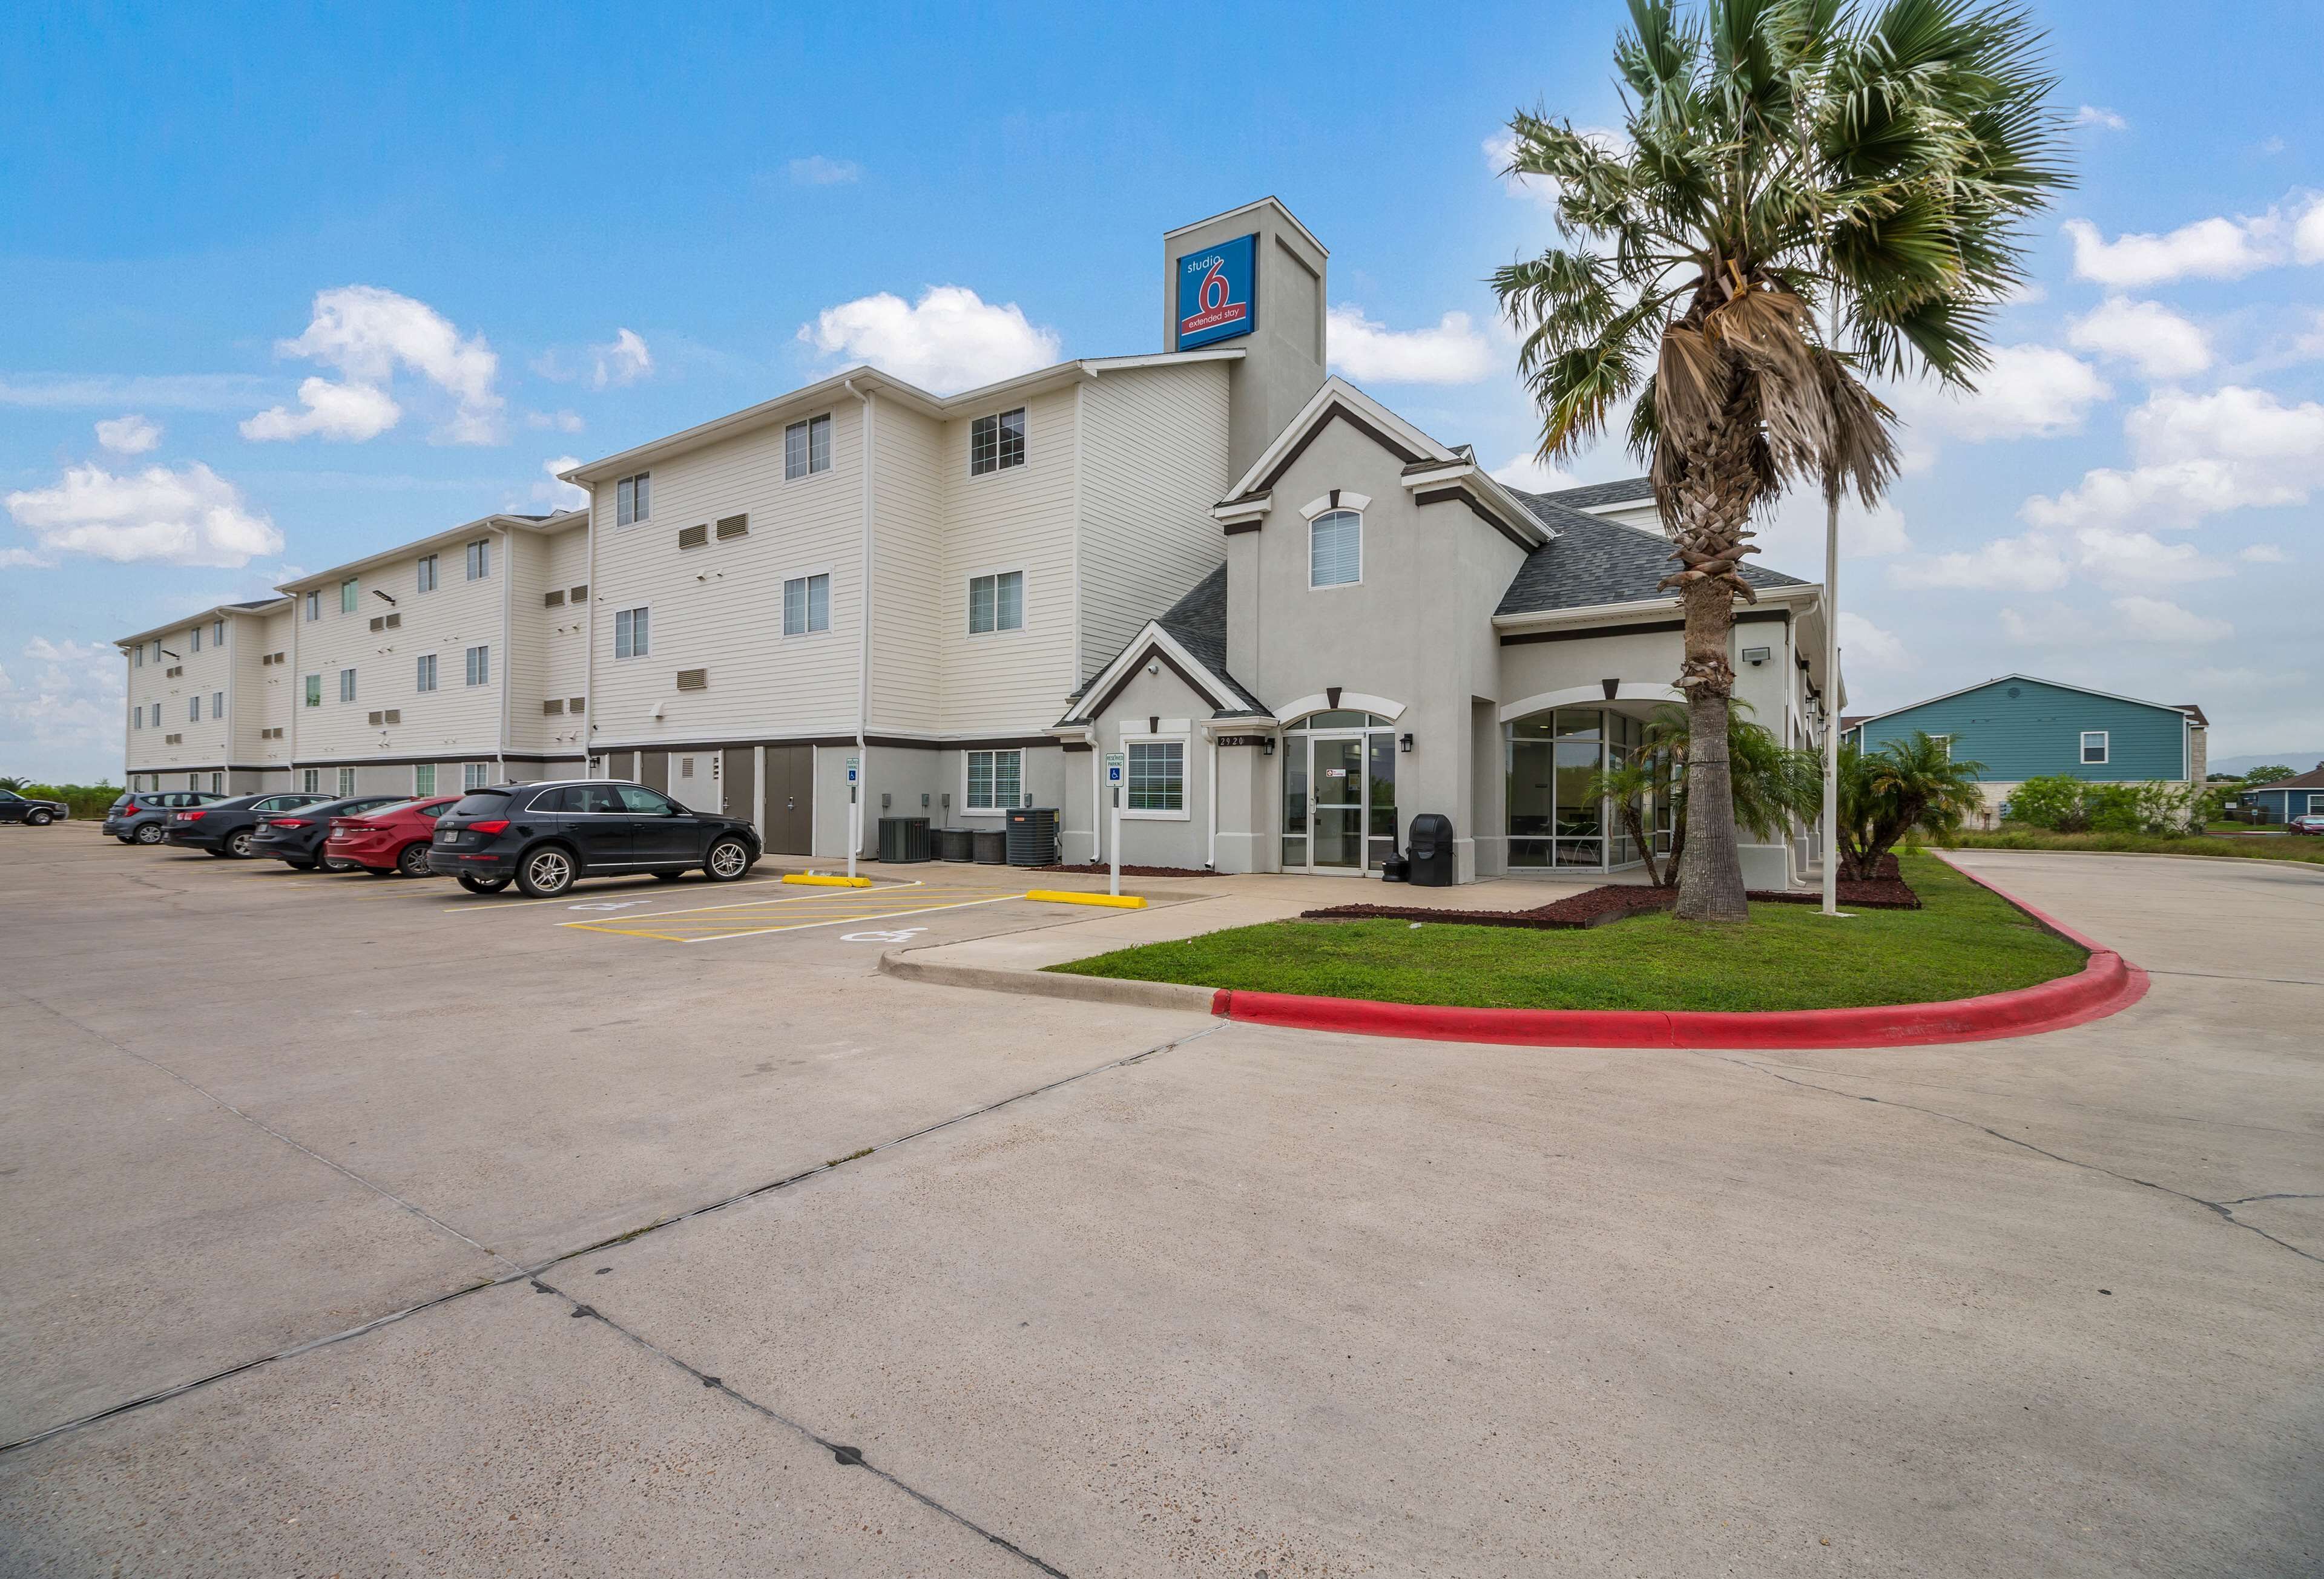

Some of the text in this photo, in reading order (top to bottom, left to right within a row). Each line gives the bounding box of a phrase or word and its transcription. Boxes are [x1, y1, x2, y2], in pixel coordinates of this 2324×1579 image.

[1188, 255, 1220, 273] studio
[1199, 259, 1230, 312] 6
[1188, 309, 1239, 328] extended stay
[1220, 737, 1243, 746] 2920
